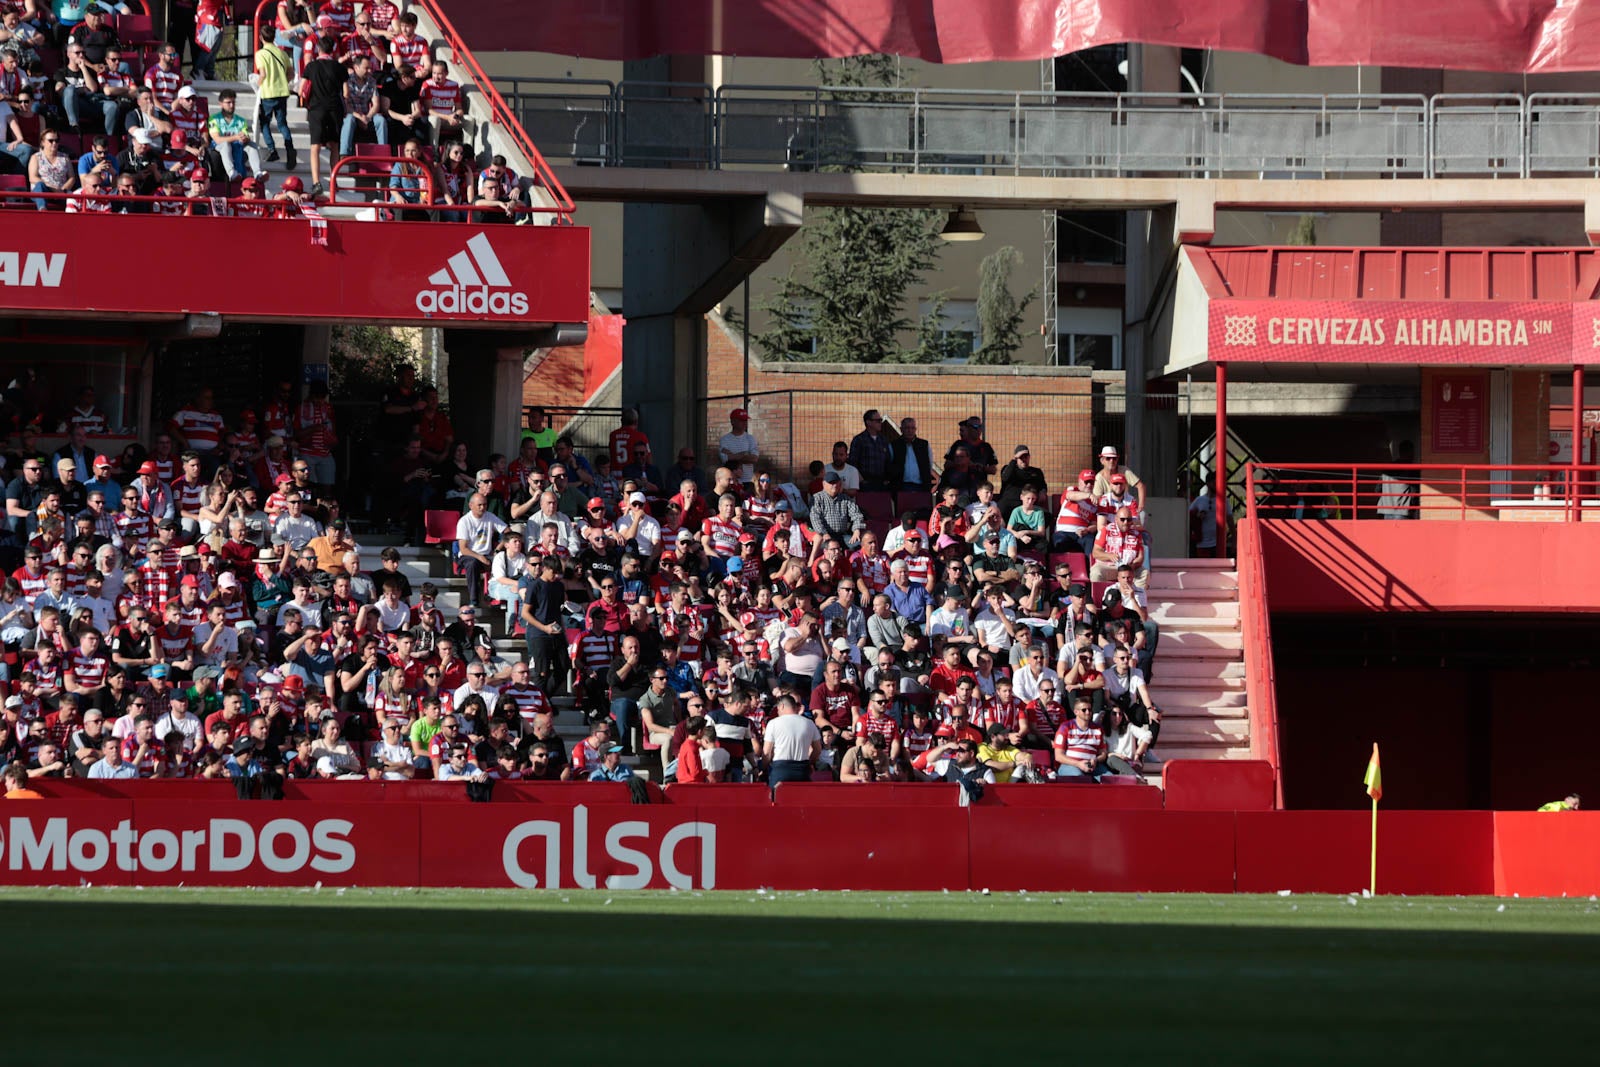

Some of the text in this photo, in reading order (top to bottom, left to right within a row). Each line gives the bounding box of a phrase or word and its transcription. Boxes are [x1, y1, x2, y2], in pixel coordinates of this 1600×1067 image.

[416, 284, 529, 315] adidas
[1268, 317, 1552, 346] CERVEZAS ALHAMBRA SIN
[615, 440, 628, 464] 5
[9, 817, 356, 873] MotorDOS
[502, 803, 717, 890] alsa
